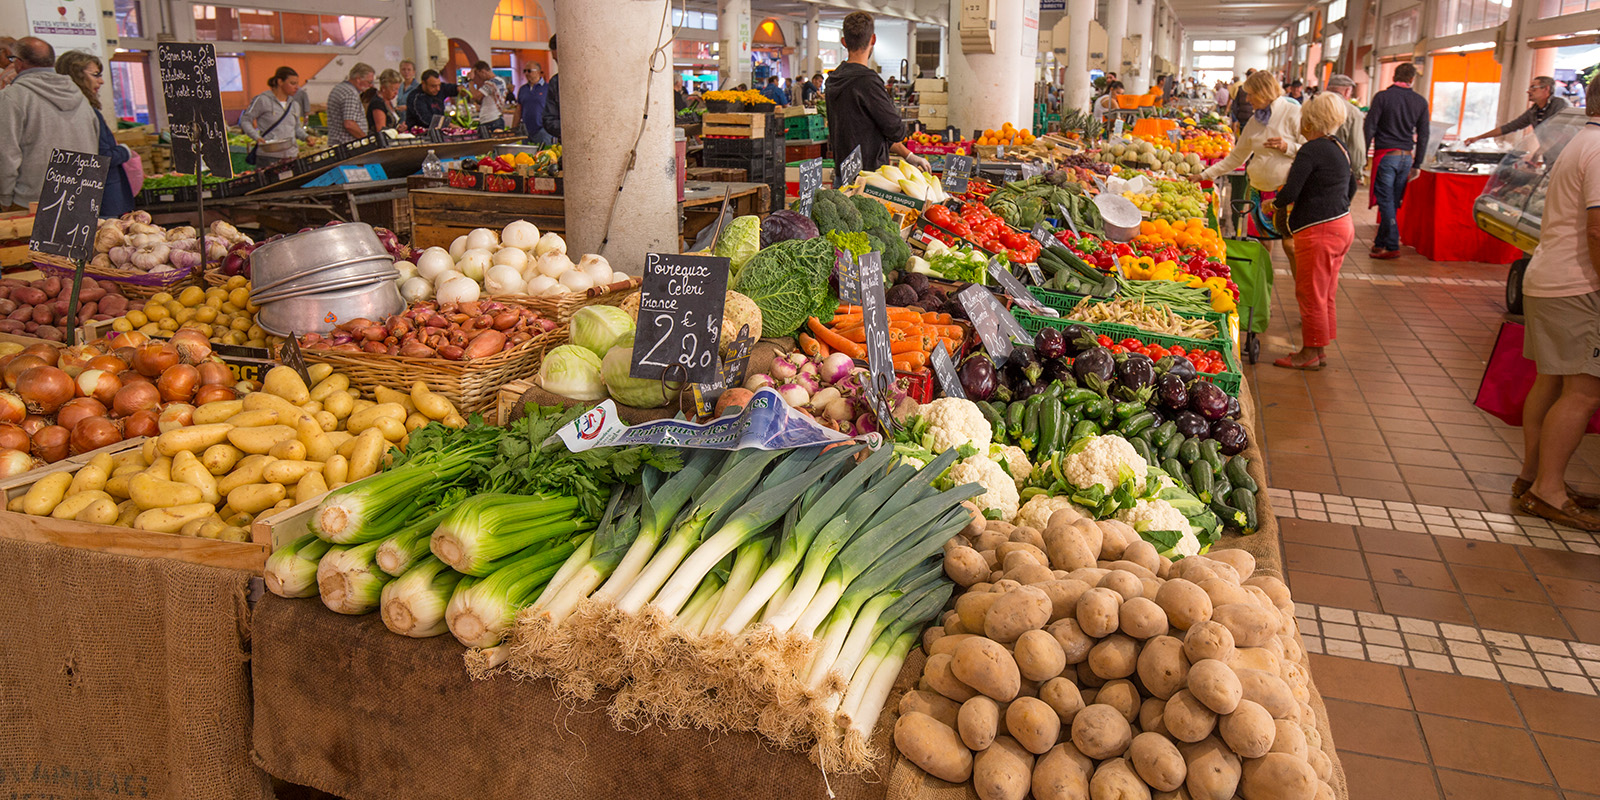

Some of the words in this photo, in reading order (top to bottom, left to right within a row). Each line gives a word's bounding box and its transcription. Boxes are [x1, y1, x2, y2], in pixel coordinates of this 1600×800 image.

[71, 154, 102, 176] Agata
[46, 167, 78, 194] Oignon
[75, 178, 104, 195] jaune
[865, 188, 885, 199] France
[893, 196, 916, 208] Endives
[90, 198, 100, 218] kg
[647, 253, 711, 277] Poireaux
[641, 292, 679, 310] France
[701, 423, 729, 437] des
